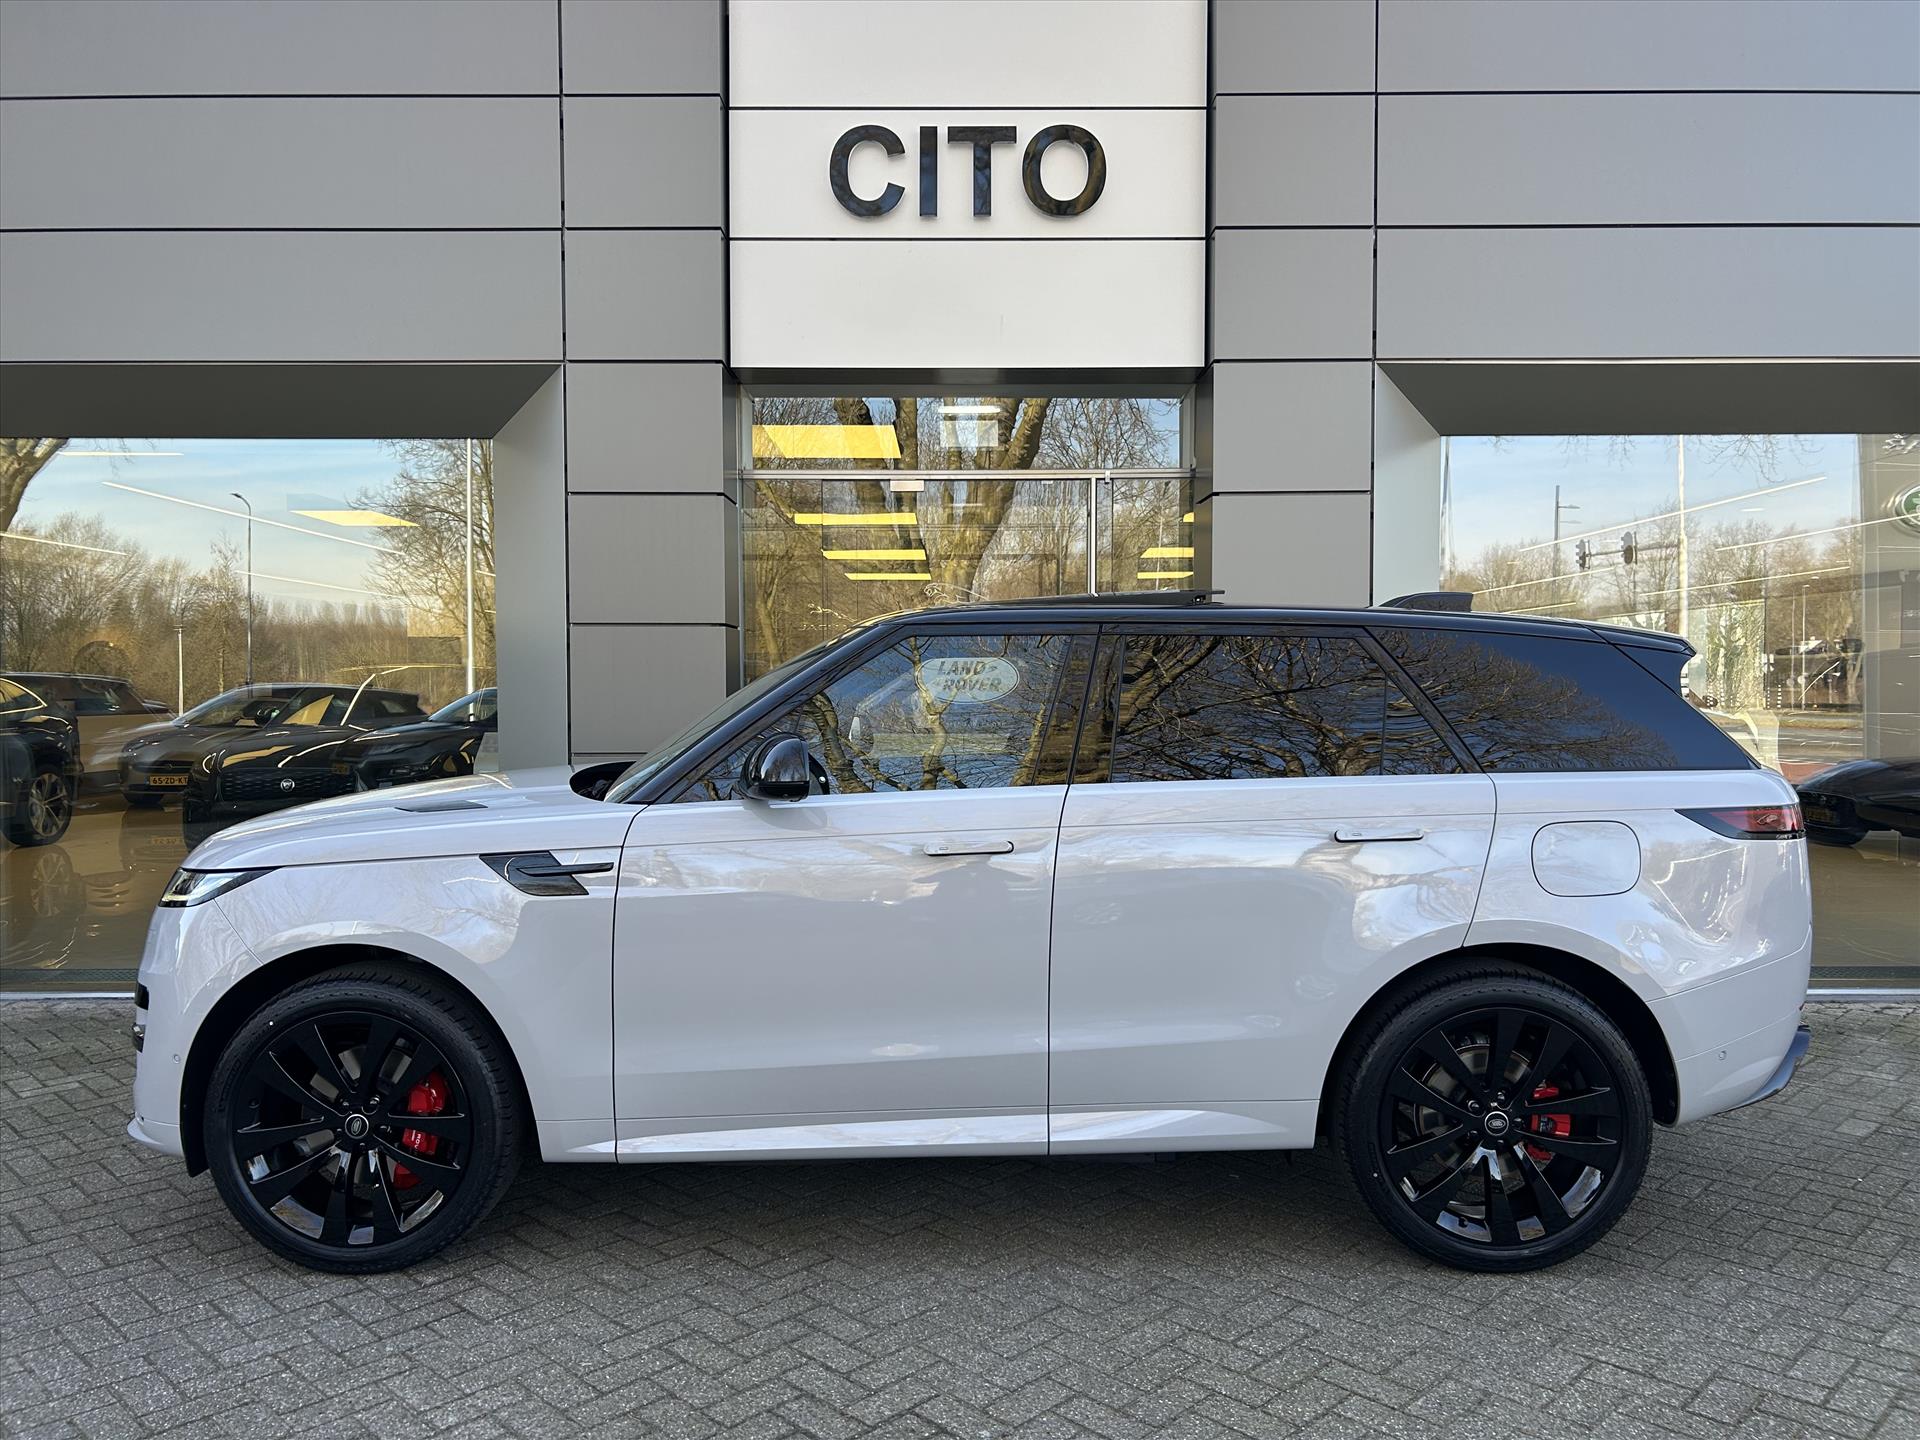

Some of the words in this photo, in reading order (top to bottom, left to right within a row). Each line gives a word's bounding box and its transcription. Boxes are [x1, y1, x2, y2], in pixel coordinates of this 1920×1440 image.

[829, 124, 1107, 217] CITO
[938, 660, 986, 676] LAND
[943, 677, 1003, 693] ROVER
